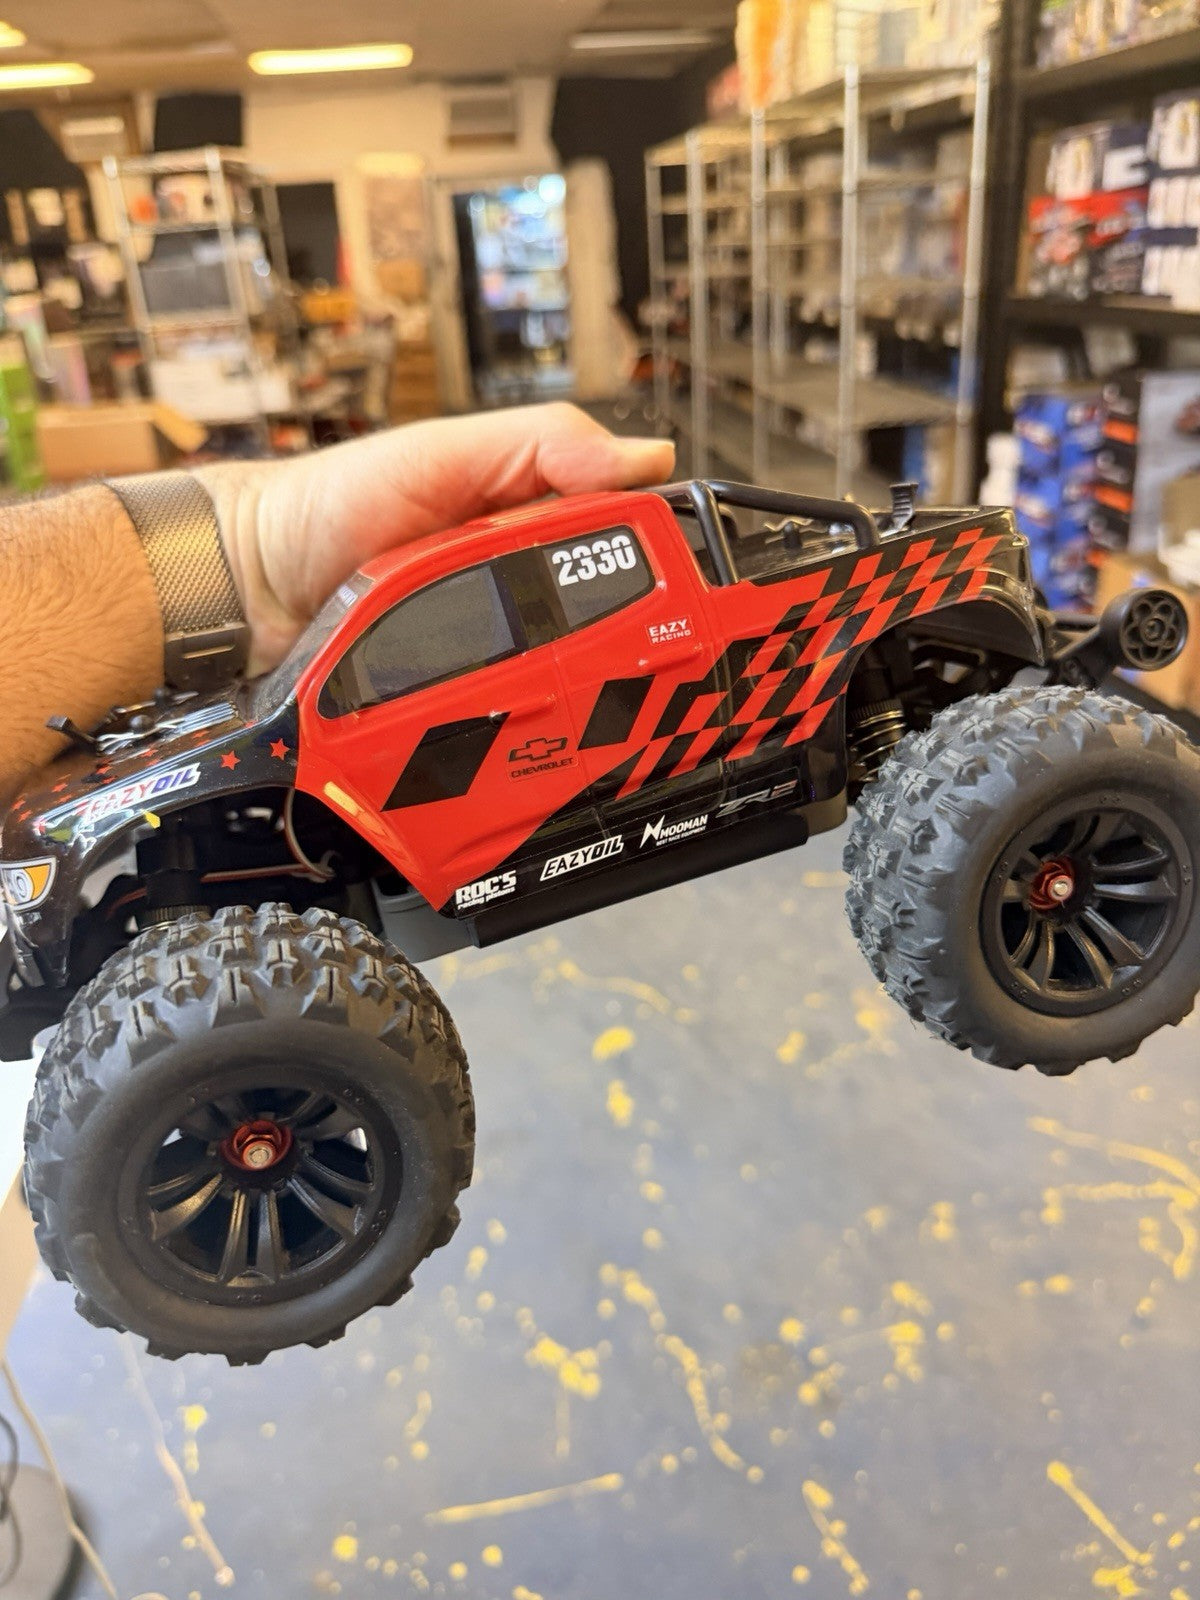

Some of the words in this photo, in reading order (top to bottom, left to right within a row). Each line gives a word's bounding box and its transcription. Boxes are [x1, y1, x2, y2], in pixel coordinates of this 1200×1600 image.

[552, 535, 636, 586] 2330
[649, 619, 687, 637] EAZY
[652, 630, 691, 643] RACING
[511, 758, 573, 778] CHEVROLET
[660, 814, 708, 839] MOOMAN
[542, 836, 622, 879] EAZYOIL
